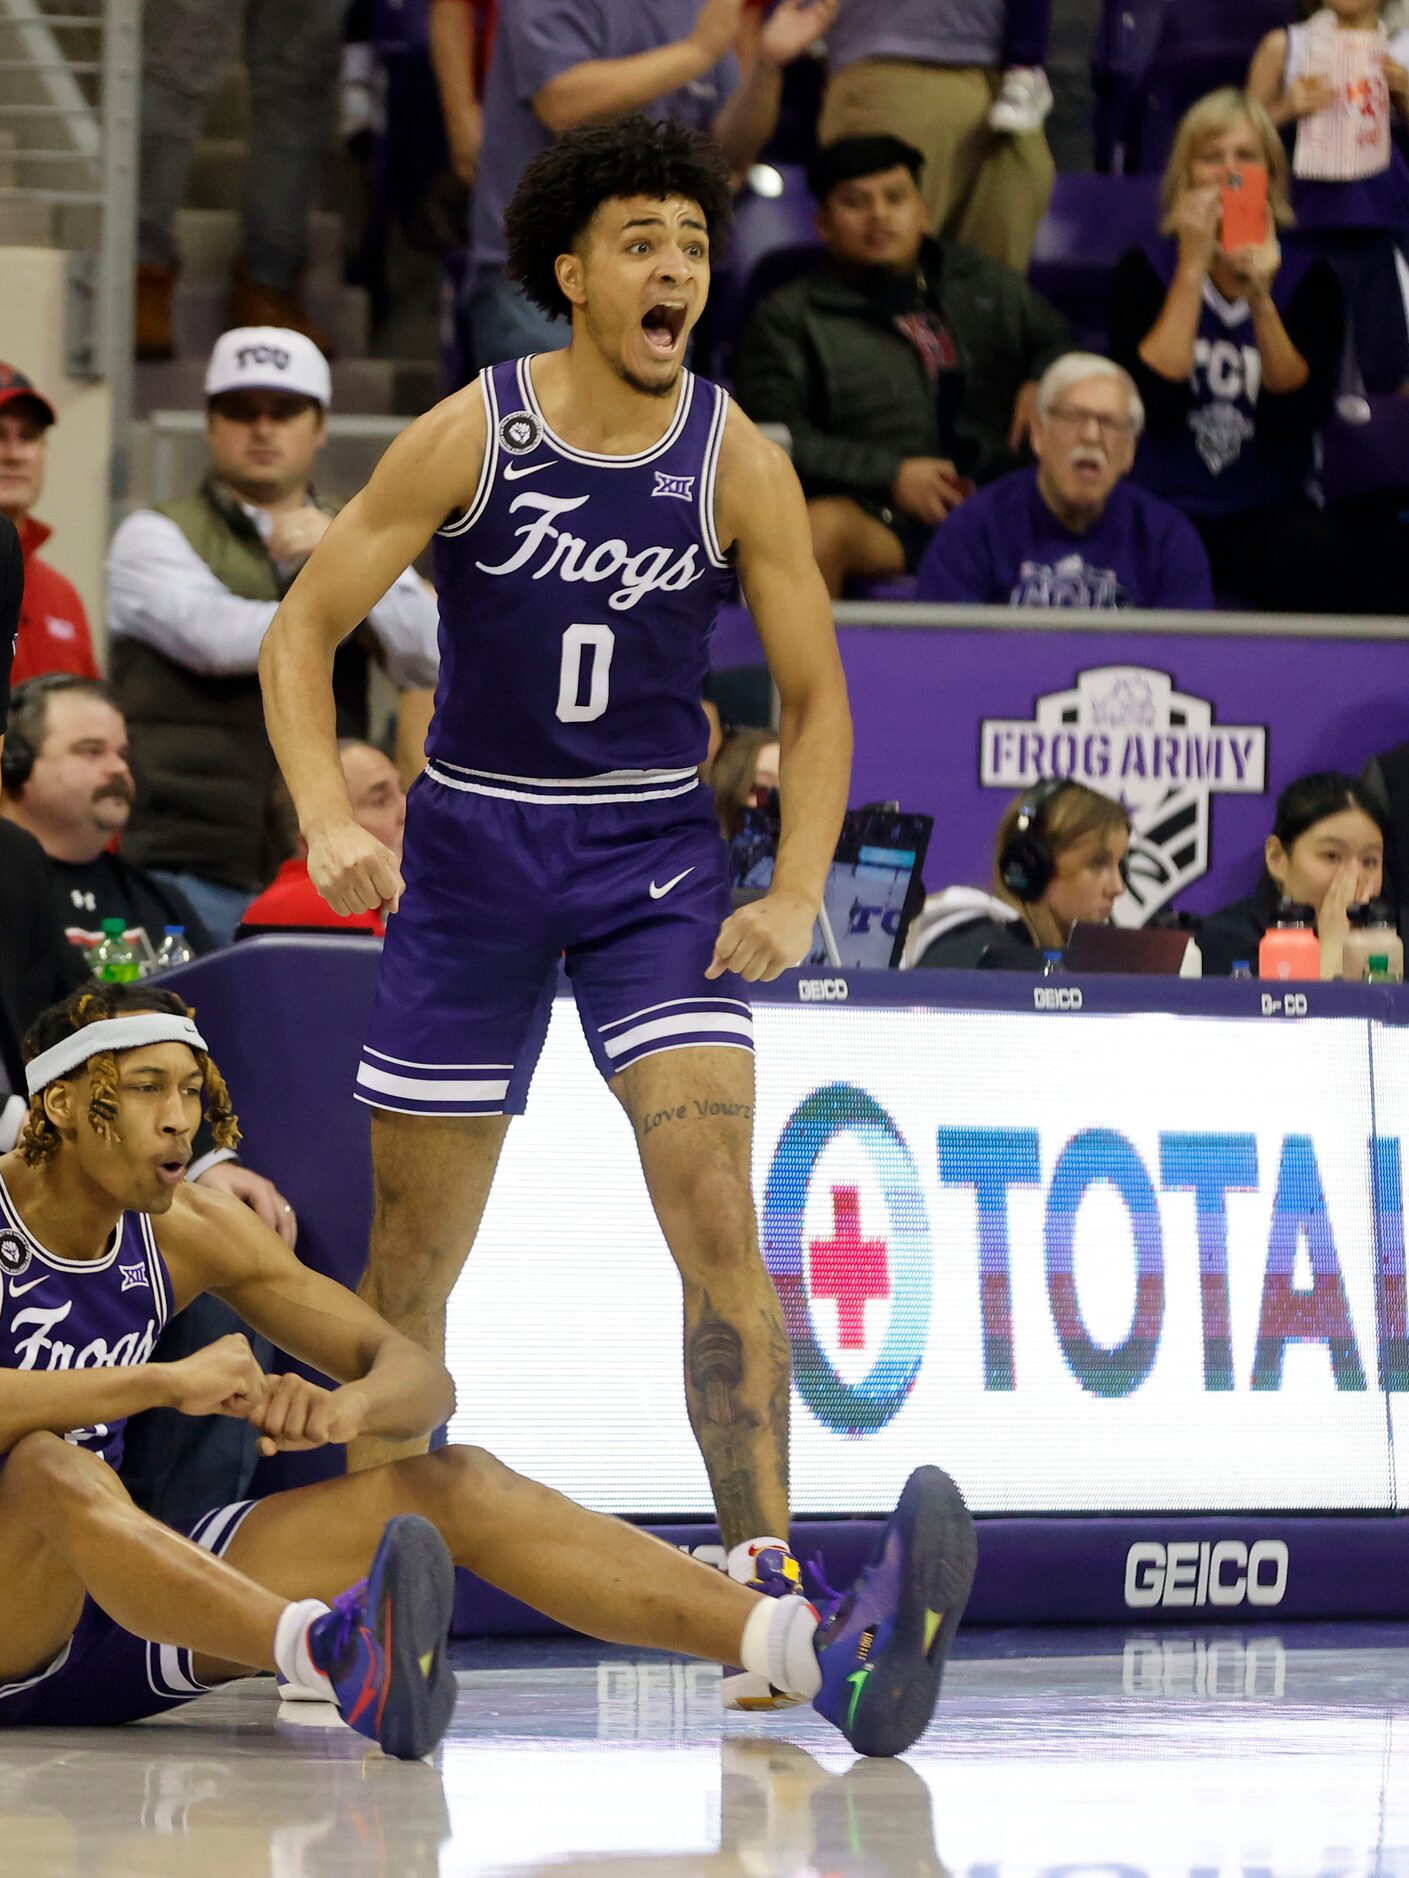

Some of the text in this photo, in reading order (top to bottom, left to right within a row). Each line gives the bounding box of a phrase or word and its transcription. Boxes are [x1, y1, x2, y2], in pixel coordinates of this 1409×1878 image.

[475, 491, 705, 611] Frogs
[555, 623, 615, 722] 0
[993, 732, 1253, 780] FROG ARMY
[798, 979, 848, 1001] GEICO
[1033, 987, 1083, 1010] GEICO
[643, 1104, 687, 1134] Love
[1124, 1540, 1289, 1608] GEICO
